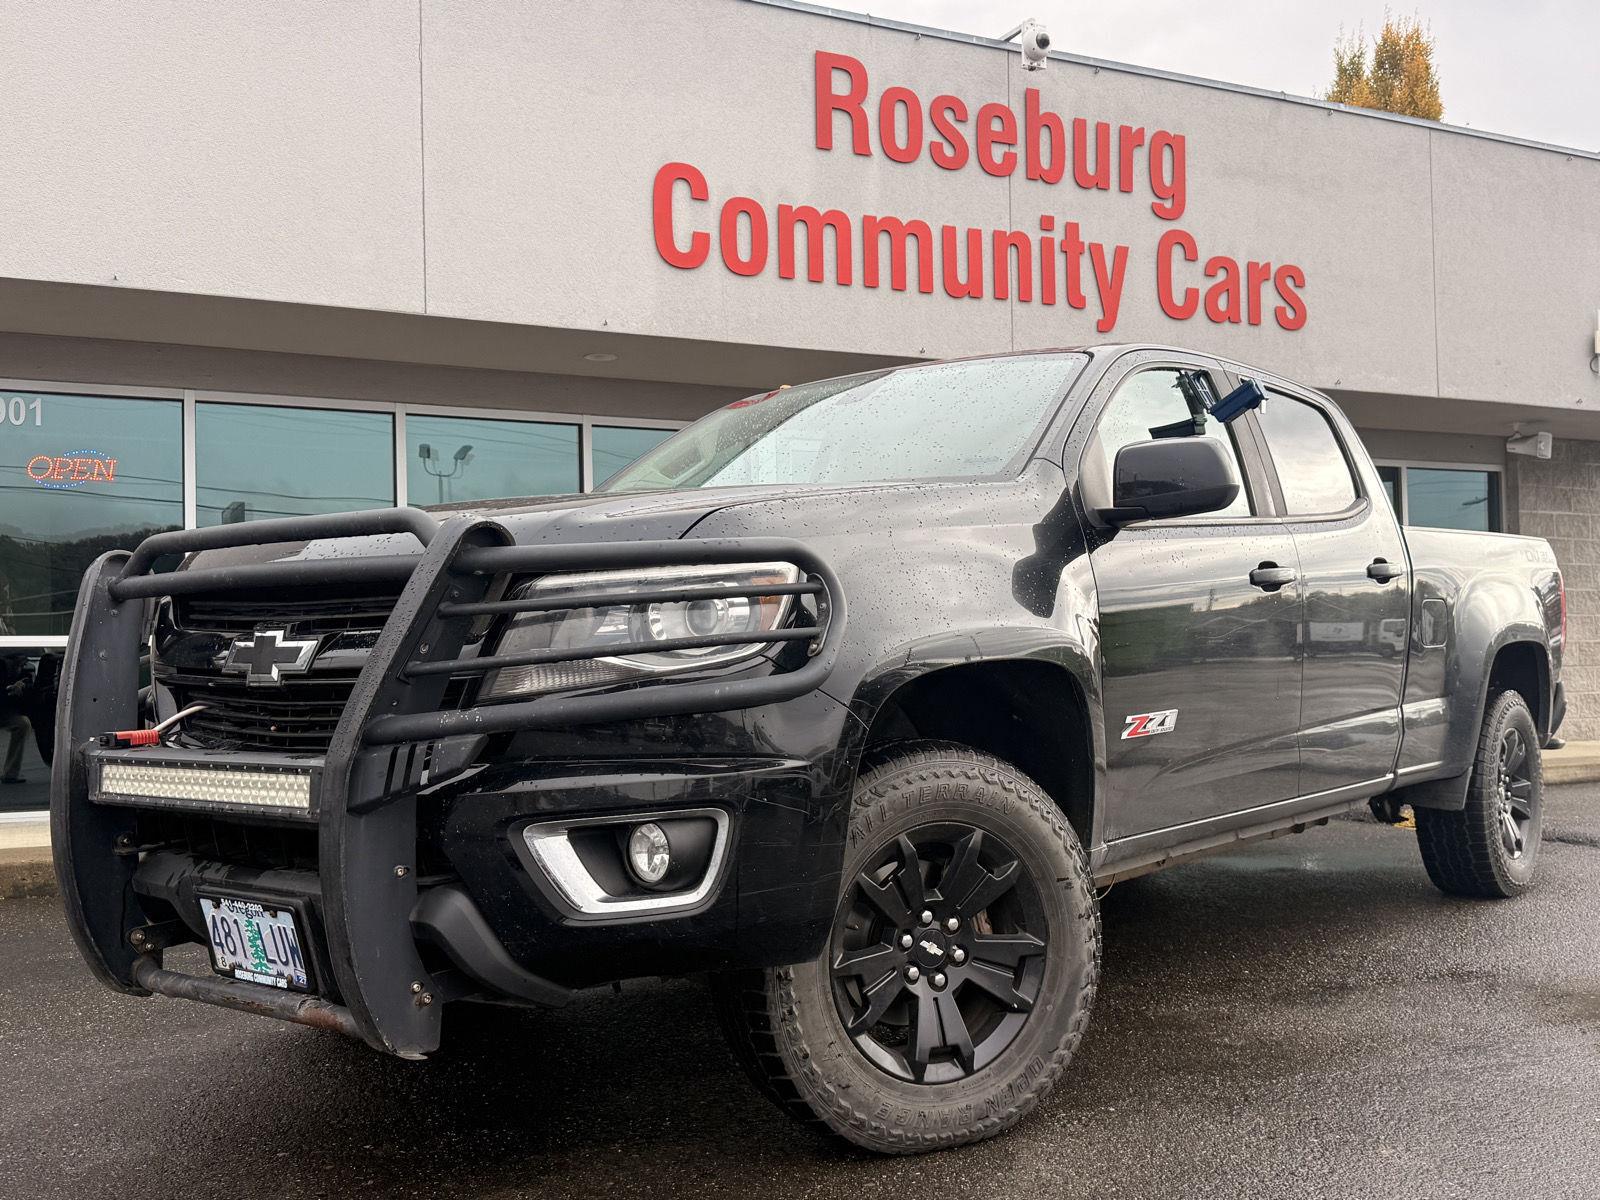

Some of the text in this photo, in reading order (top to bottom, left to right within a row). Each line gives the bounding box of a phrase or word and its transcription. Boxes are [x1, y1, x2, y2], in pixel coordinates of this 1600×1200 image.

[815, 50, 1187, 221] Roseburg
[653, 161, 1307, 333] Community Cars
[27, 454, 118, 482] OPEN
[1121, 709, 1179, 740] Z71
[902, 782, 1016, 815] TERRAIN
[211, 914, 305, 969] 481 LUW
